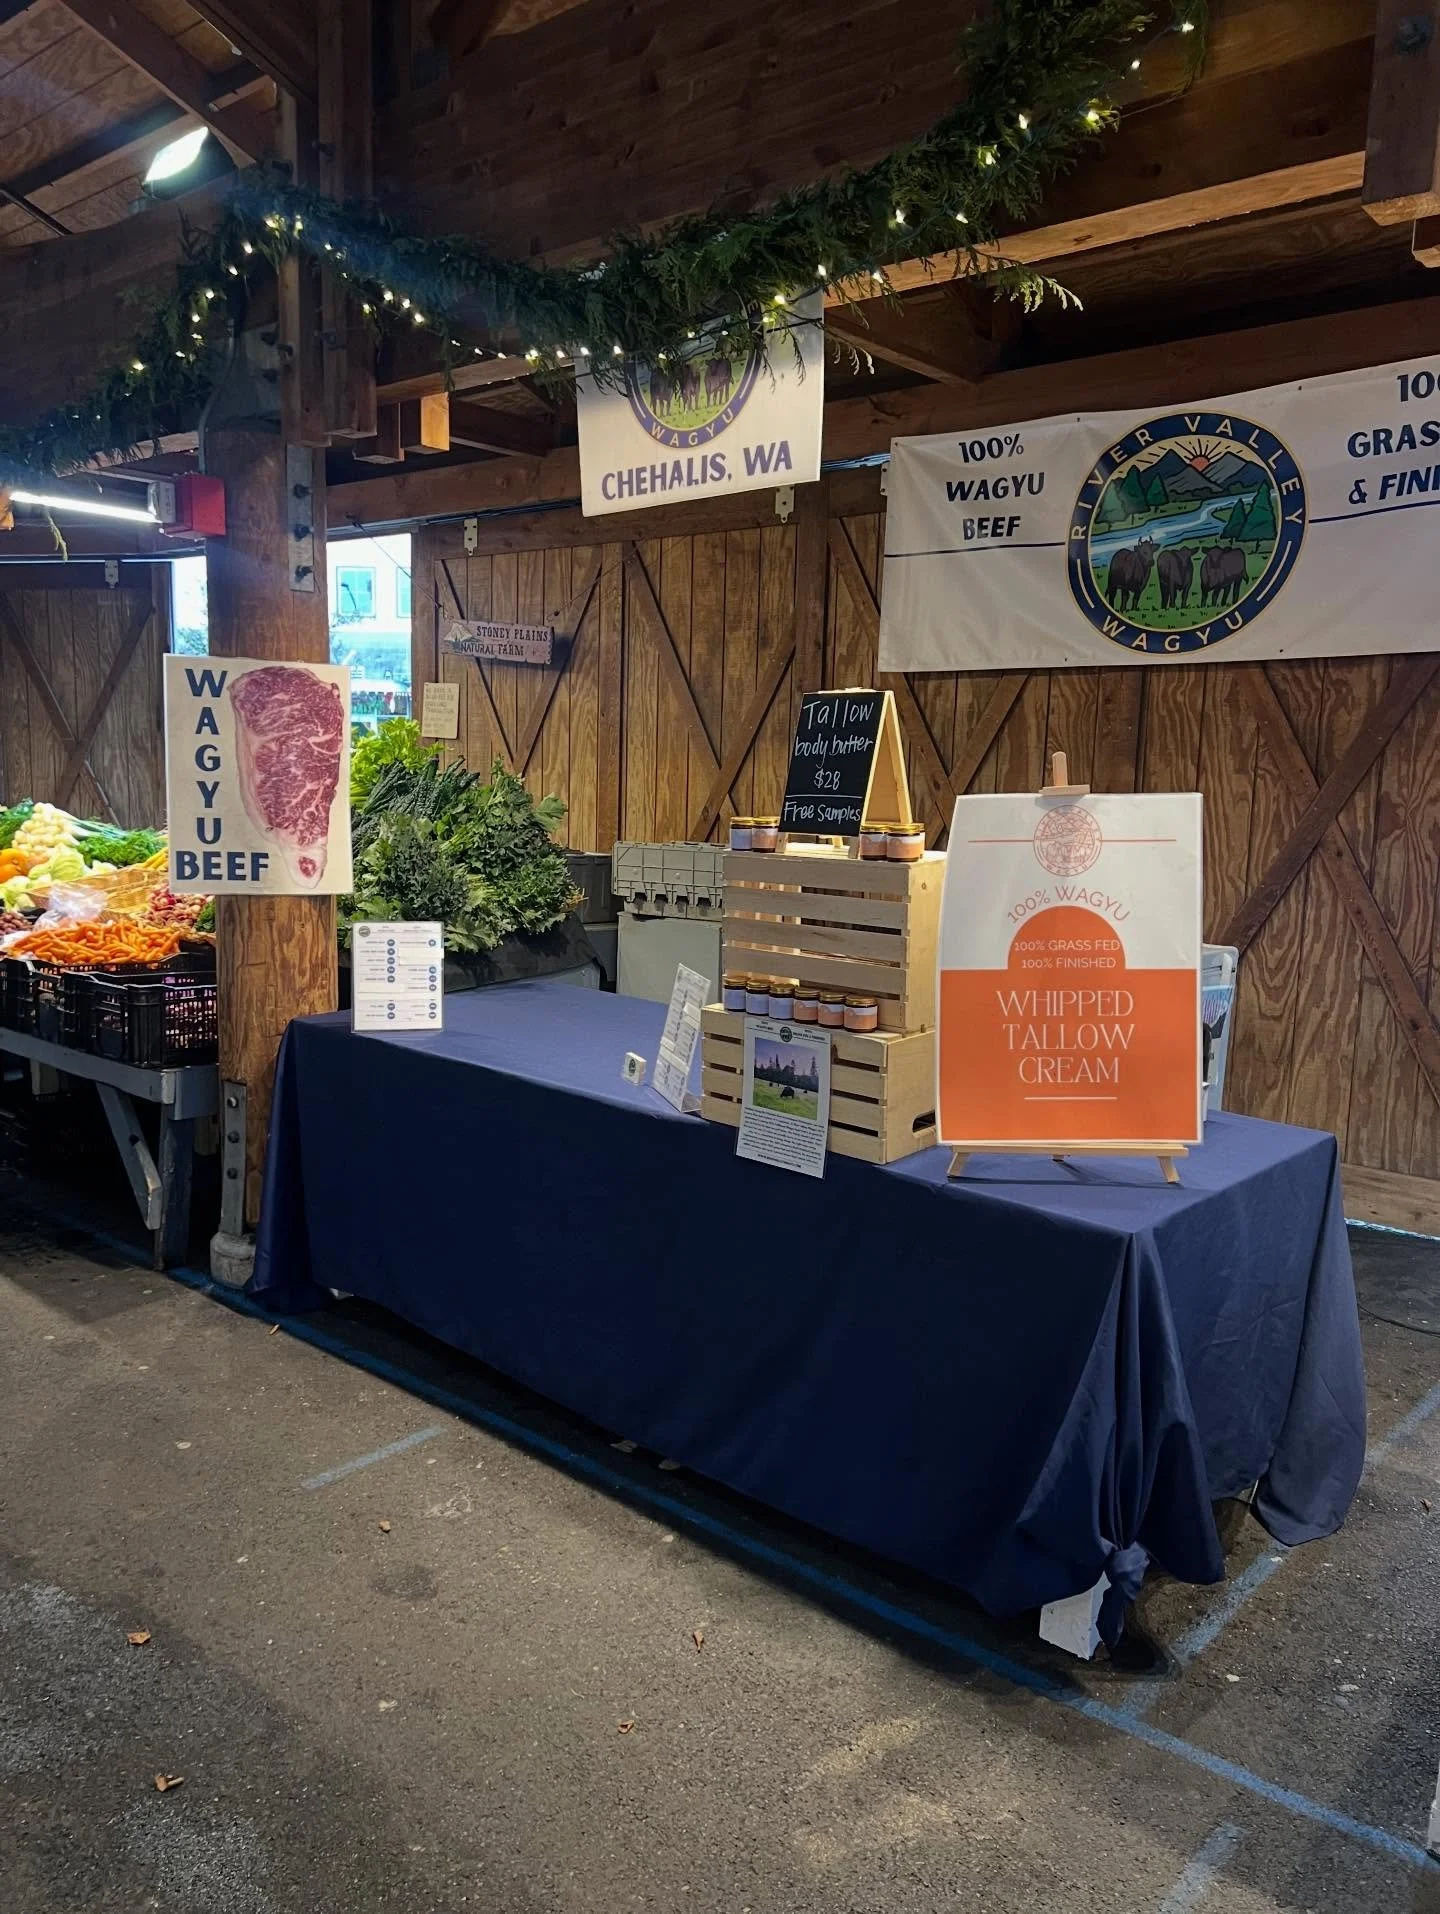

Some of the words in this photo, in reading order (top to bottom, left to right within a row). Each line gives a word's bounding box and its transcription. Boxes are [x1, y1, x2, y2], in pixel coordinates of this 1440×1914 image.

[1397, 371, 1440, 402] 10
[649, 408, 734, 447] WAGYU
[958, 433, 1024, 463] 100%
[601, 452, 733, 500] CHEHALIS,
[742, 440, 793, 476] WA
[1070, 427, 1153, 540] RIVER
[1184, 416, 1304, 524] VALLEY
[946, 472, 1045, 502] WAGYU
[1348, 478, 1368, 505] &
[962, 515, 1022, 540] BEEF
[476, 625, 511, 640] STONEY
[514, 628, 548, 642] PLAINS
[1102, 610, 1244, 652] WAGYU
[461, 641, 495, 656] NATURAL
[498, 643, 524, 656] FARM
[803, 698, 874, 730] Tallow
[184, 668, 229, 845] WAGYU
[794, 732, 829, 769] body
[829, 733, 874, 756] butter
[813, 768, 841, 791] $28
[783, 801, 815, 822] Free
[175, 850, 270, 881] BEEF
[1007, 889, 1051, 924] 100%
[1055, 885, 1130, 921] WAGYU
[1014, 939, 1046, 952] 100%
[1048, 939, 1092, 952] GRASS
[1095, 939, 1121, 952] FED
[1021, 957, 1053, 969] 100%
[1056, 957, 1117, 969] FINISHED
[996, 990, 1135, 1017] WHIPPED
[1002, 1023, 1136, 1051] TALLOW
[1018, 1056, 1120, 1084] CREAM
